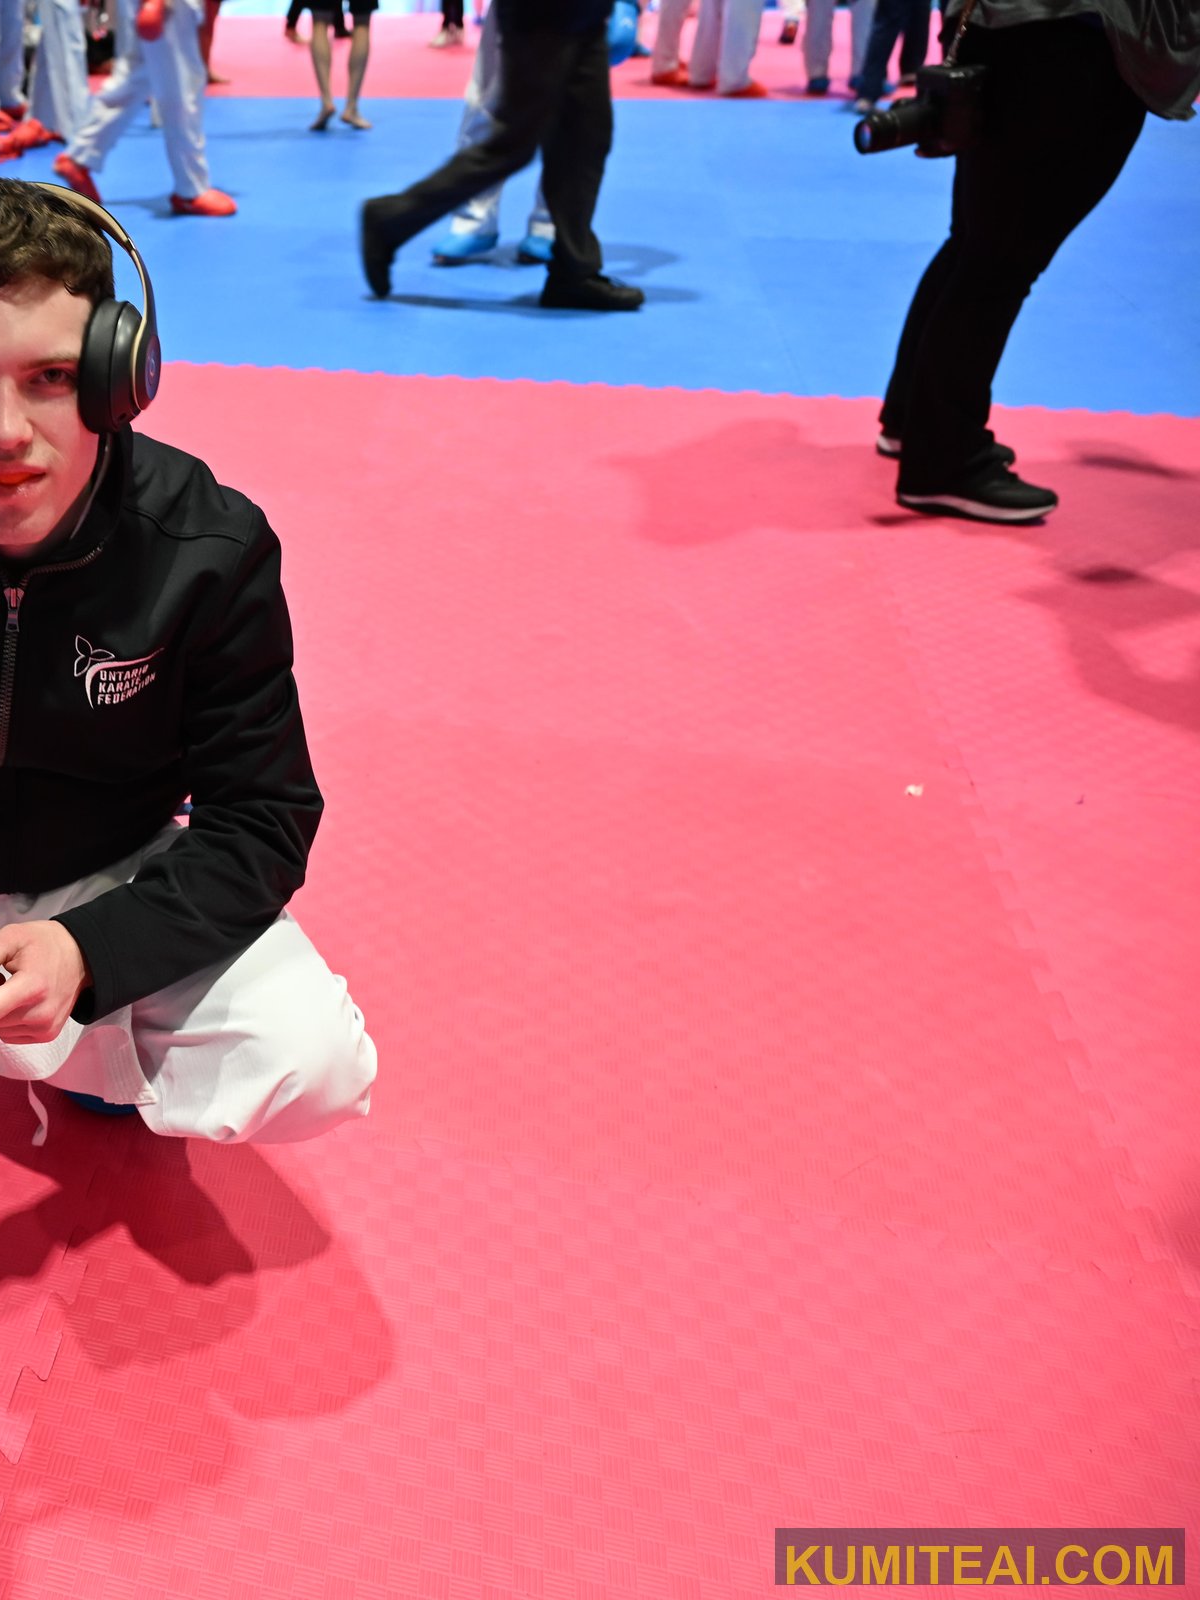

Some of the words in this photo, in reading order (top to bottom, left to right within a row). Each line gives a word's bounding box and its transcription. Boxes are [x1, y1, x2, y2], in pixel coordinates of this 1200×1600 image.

[100, 664, 149, 681] ONTARIO
[97, 673, 156, 705] FEDERATION
[98, 678, 141, 693] KARATE
